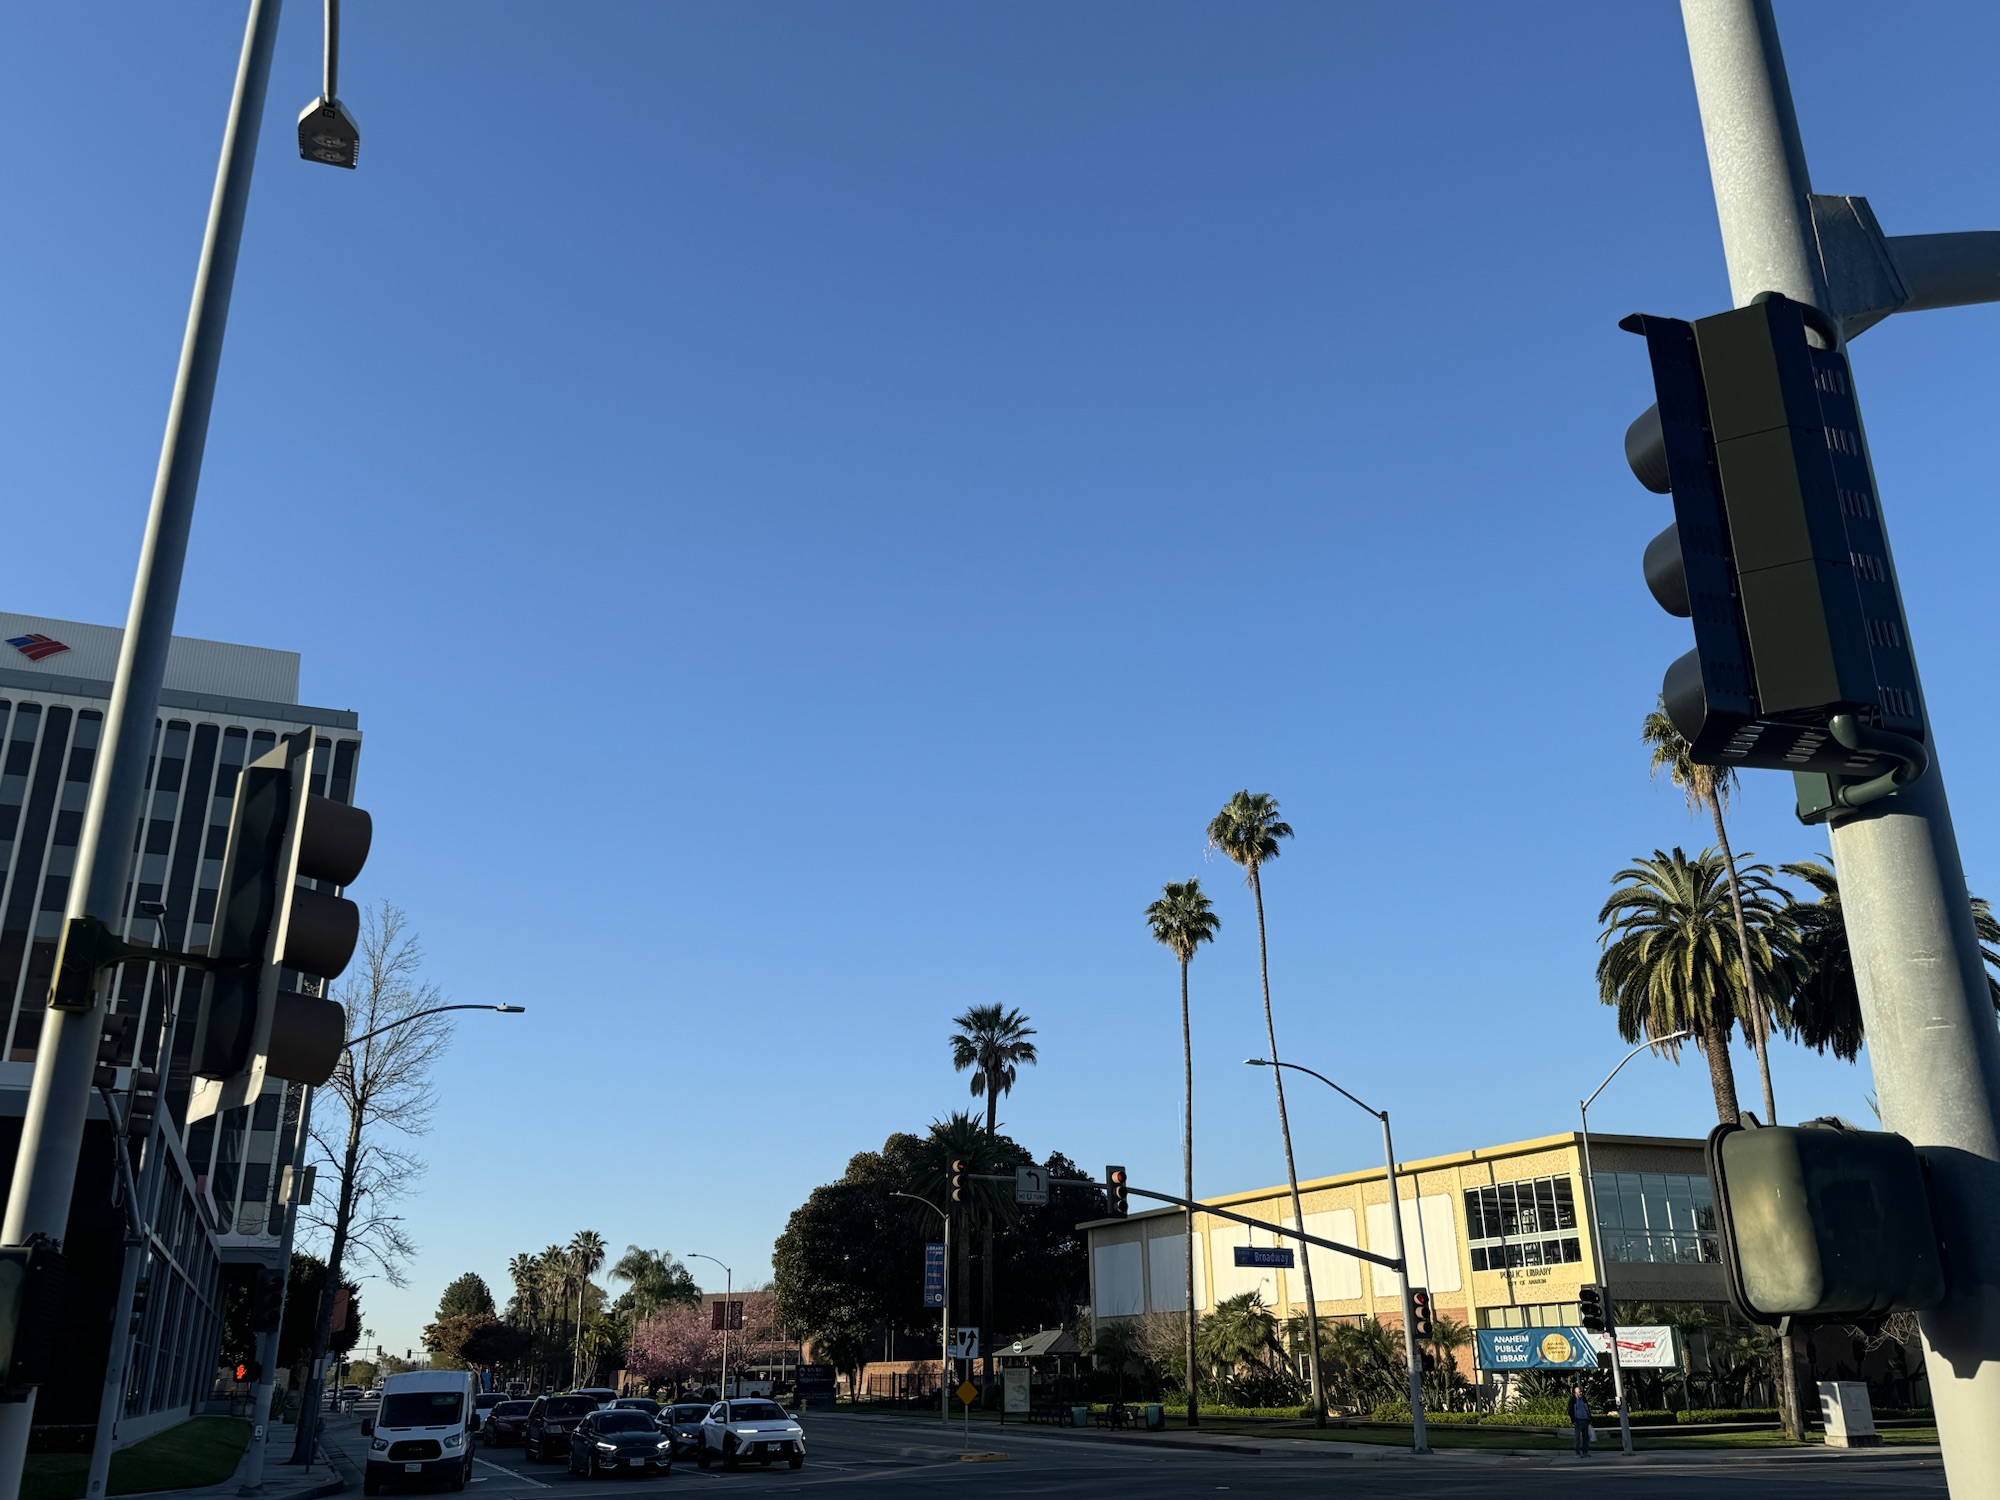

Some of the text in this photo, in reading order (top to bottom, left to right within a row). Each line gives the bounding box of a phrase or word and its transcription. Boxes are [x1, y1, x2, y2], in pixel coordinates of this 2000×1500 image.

[1254, 1251, 1289, 1265] Broadway
[1526, 1267, 1551, 1277] LIBRARY
[1493, 1335, 1529, 1343] ANAHEIM
[1495, 1345, 1524, 1353] PUBLIC
[1496, 1354, 1528, 1363] LIBRARY
